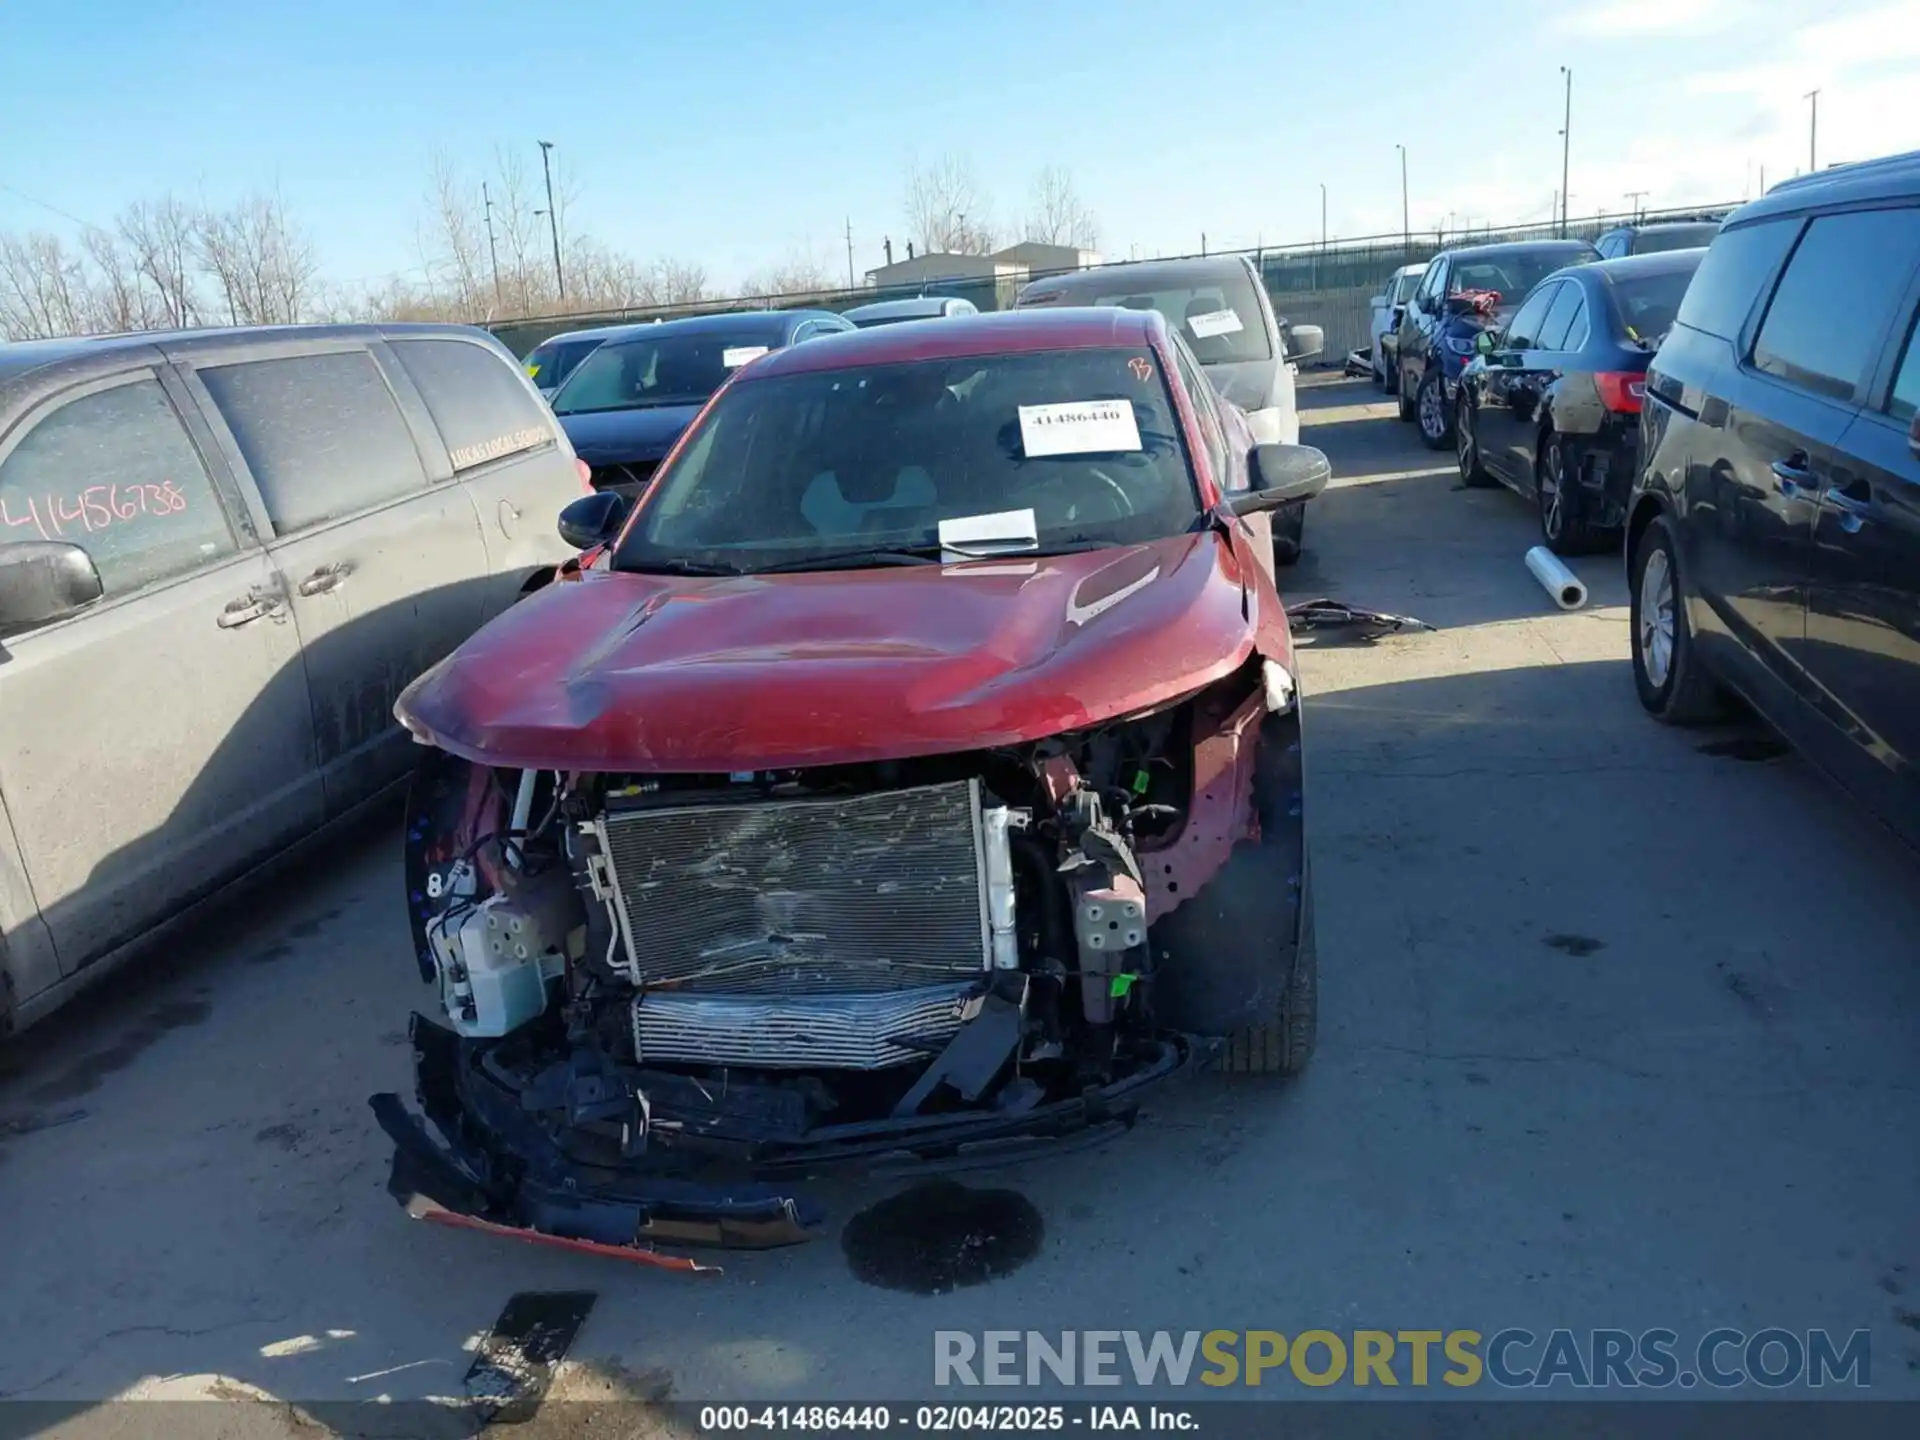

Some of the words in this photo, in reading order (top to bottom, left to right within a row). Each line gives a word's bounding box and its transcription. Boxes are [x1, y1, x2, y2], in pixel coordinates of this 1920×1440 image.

[1032, 410, 1120, 426] 41486440
[450, 443, 486, 469] LUCAS
[0, 480, 187, 541] 41456738
